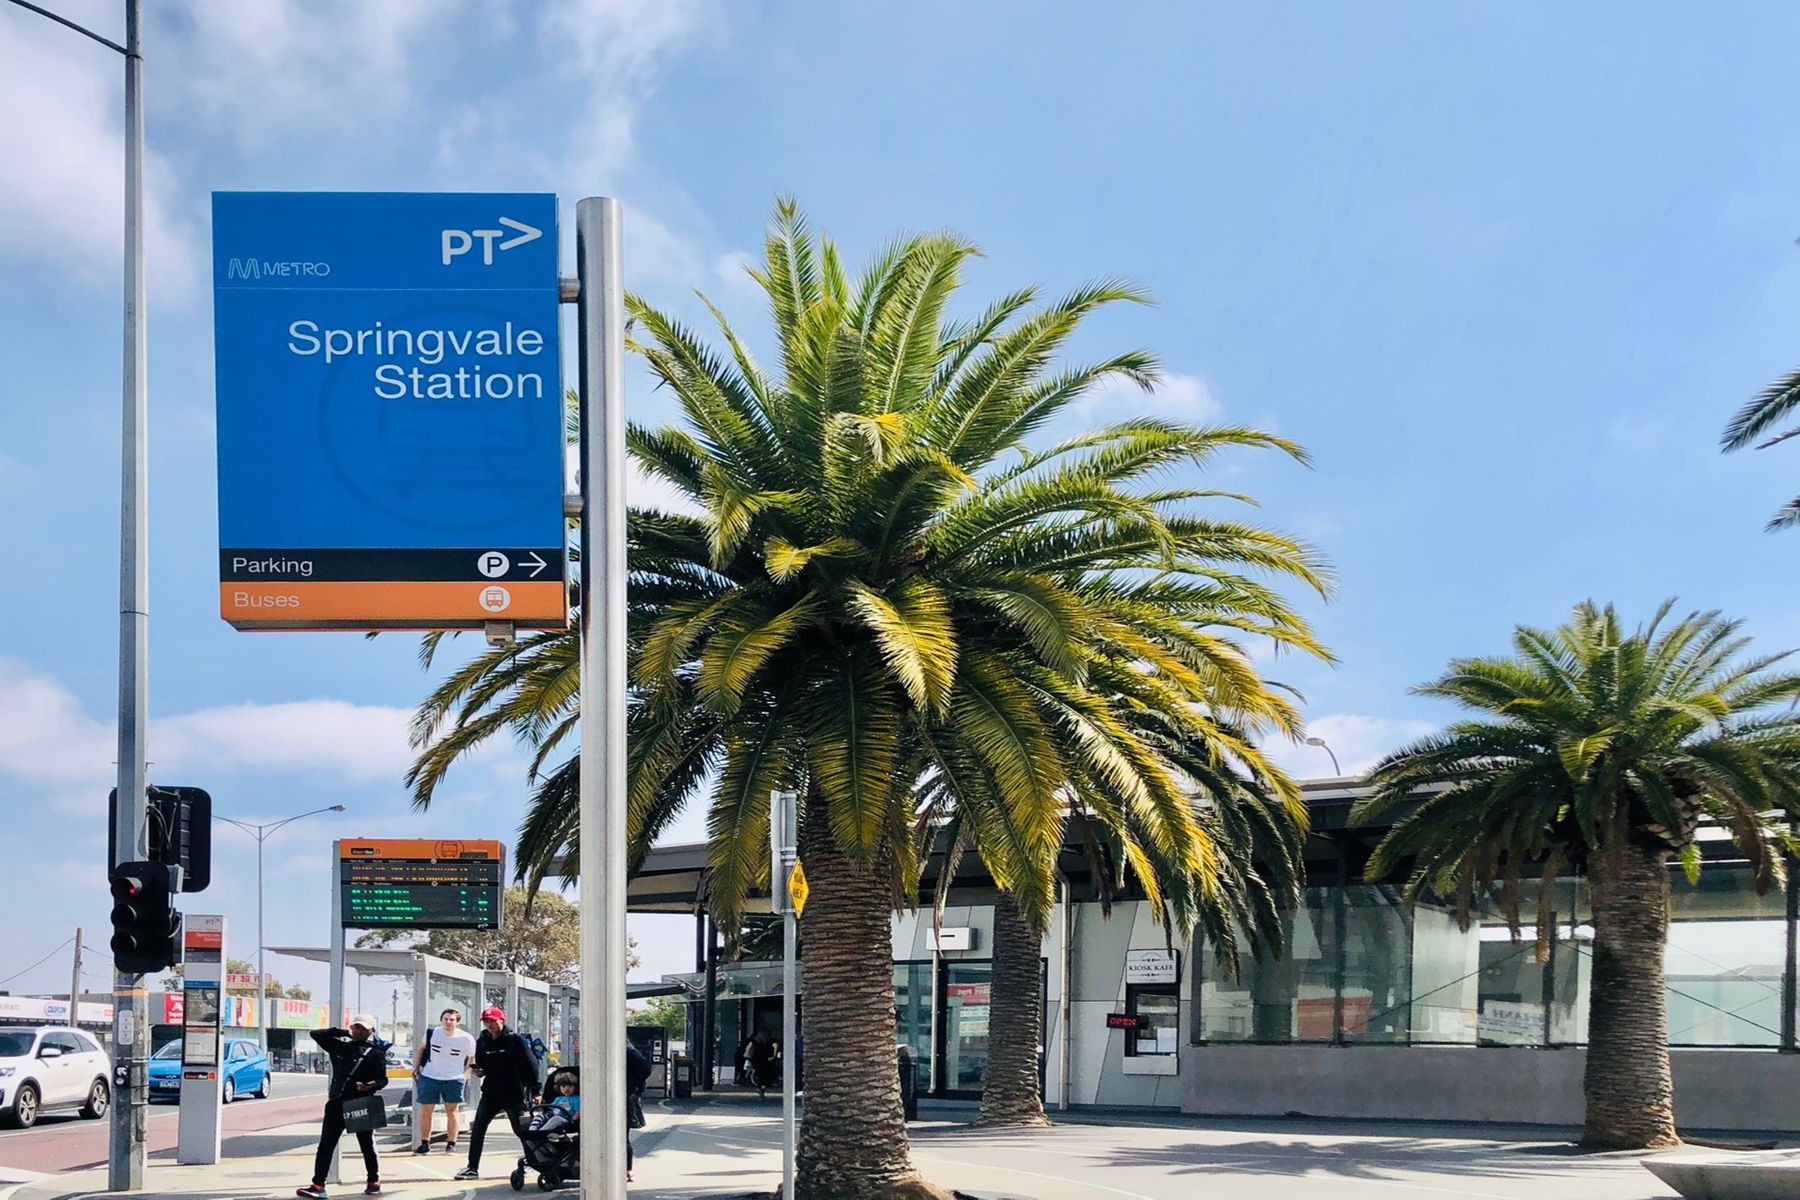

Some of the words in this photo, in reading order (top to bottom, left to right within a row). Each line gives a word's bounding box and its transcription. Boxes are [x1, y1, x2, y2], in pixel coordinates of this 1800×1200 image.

[263, 262, 330, 276] METRO
[288, 320, 544, 364] Springvale
[374, 364, 543, 399] Station
[233, 557, 313, 577] Parking
[234, 592, 300, 608] Buses
[1129, 964, 1153, 972] KIOSK
[1109, 1017, 1137, 1026] OPEN
